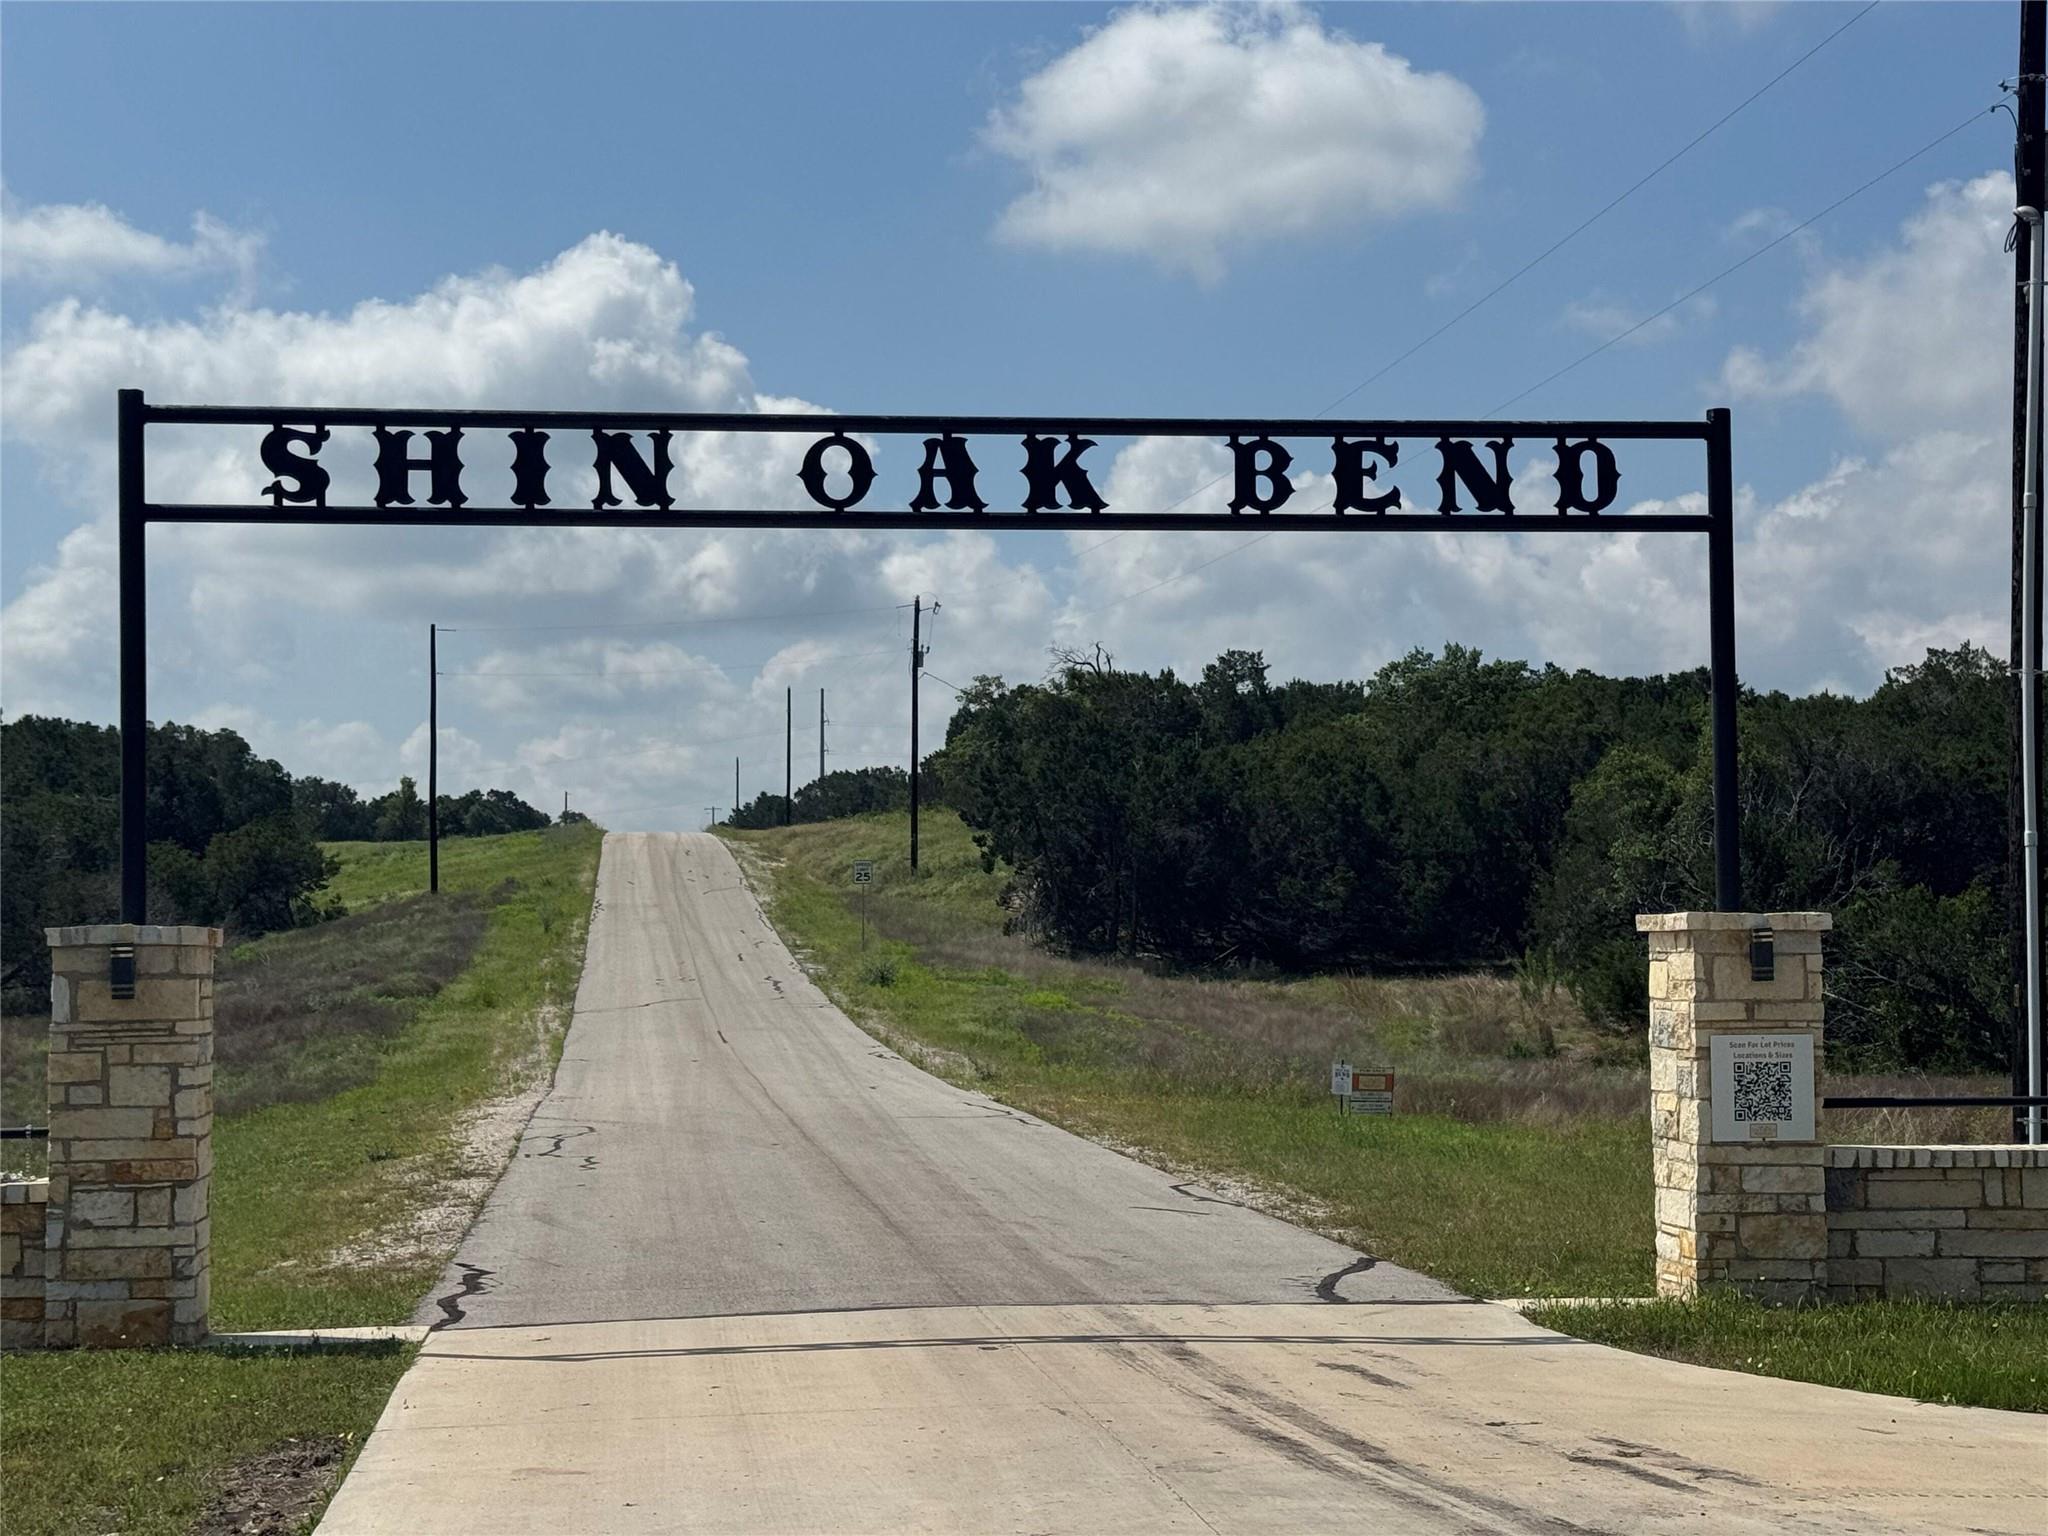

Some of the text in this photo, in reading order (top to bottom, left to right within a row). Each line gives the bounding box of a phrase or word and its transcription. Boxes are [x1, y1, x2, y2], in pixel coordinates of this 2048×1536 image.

[260, 426, 1622, 515] SHIN OAK BEND
[855, 872, 871, 882] 25
[1729, 1041, 1795, 1049] Scan For Lot Prices
[1733, 1052, 1767, 1060] Locations
